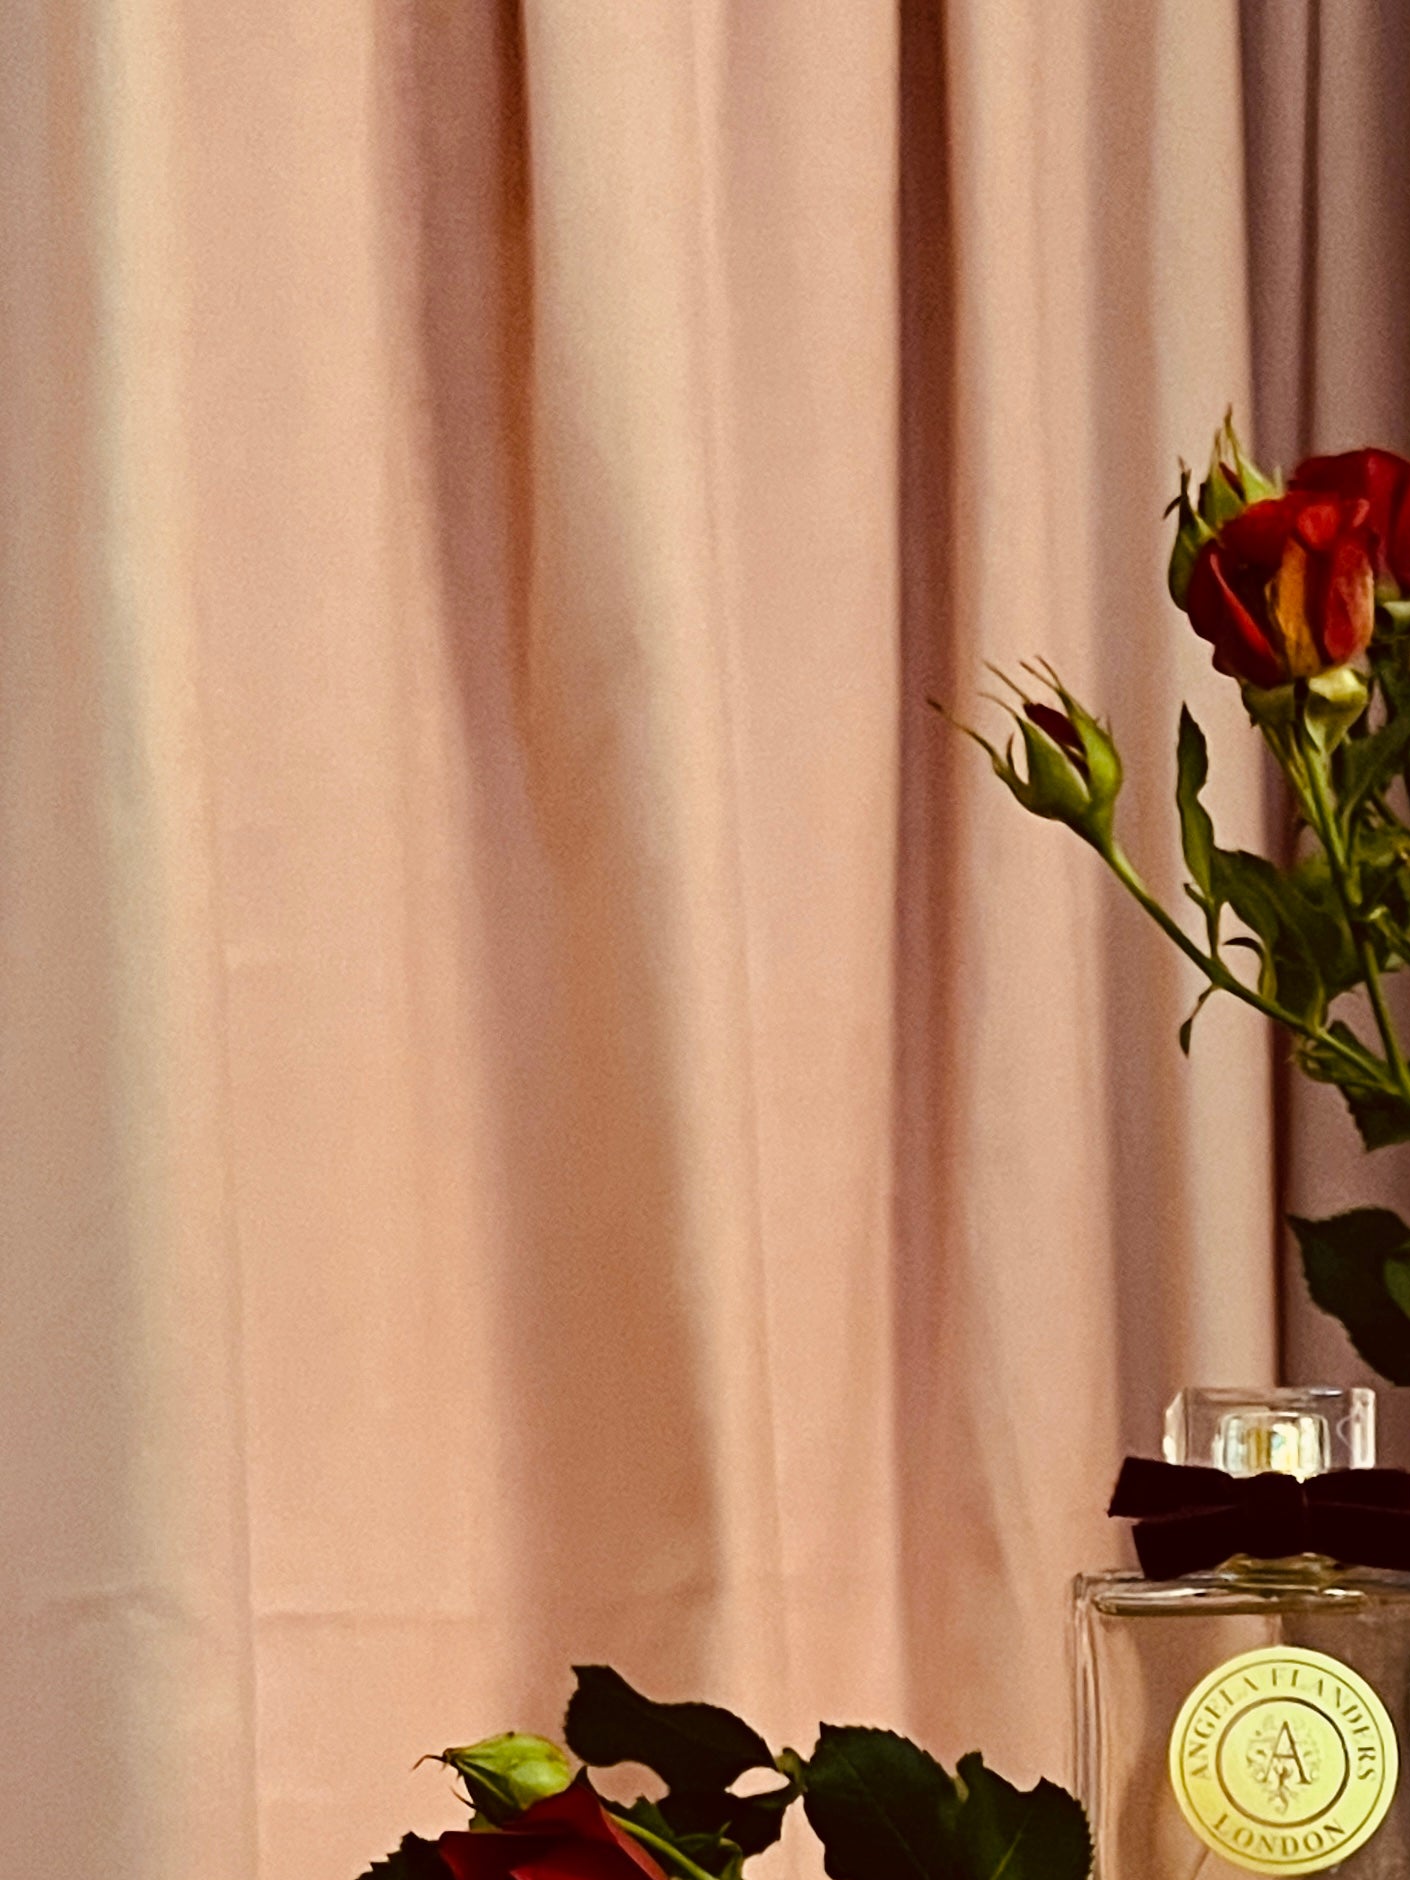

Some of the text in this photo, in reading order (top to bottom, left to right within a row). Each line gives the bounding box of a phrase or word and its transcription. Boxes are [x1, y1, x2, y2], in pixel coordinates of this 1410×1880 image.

[1187, 1667, 1377, 1781] ANGELA FLANDERS
[1263, 1720, 1311, 1785] A
[1212, 1812, 1346, 1857] LONDON
